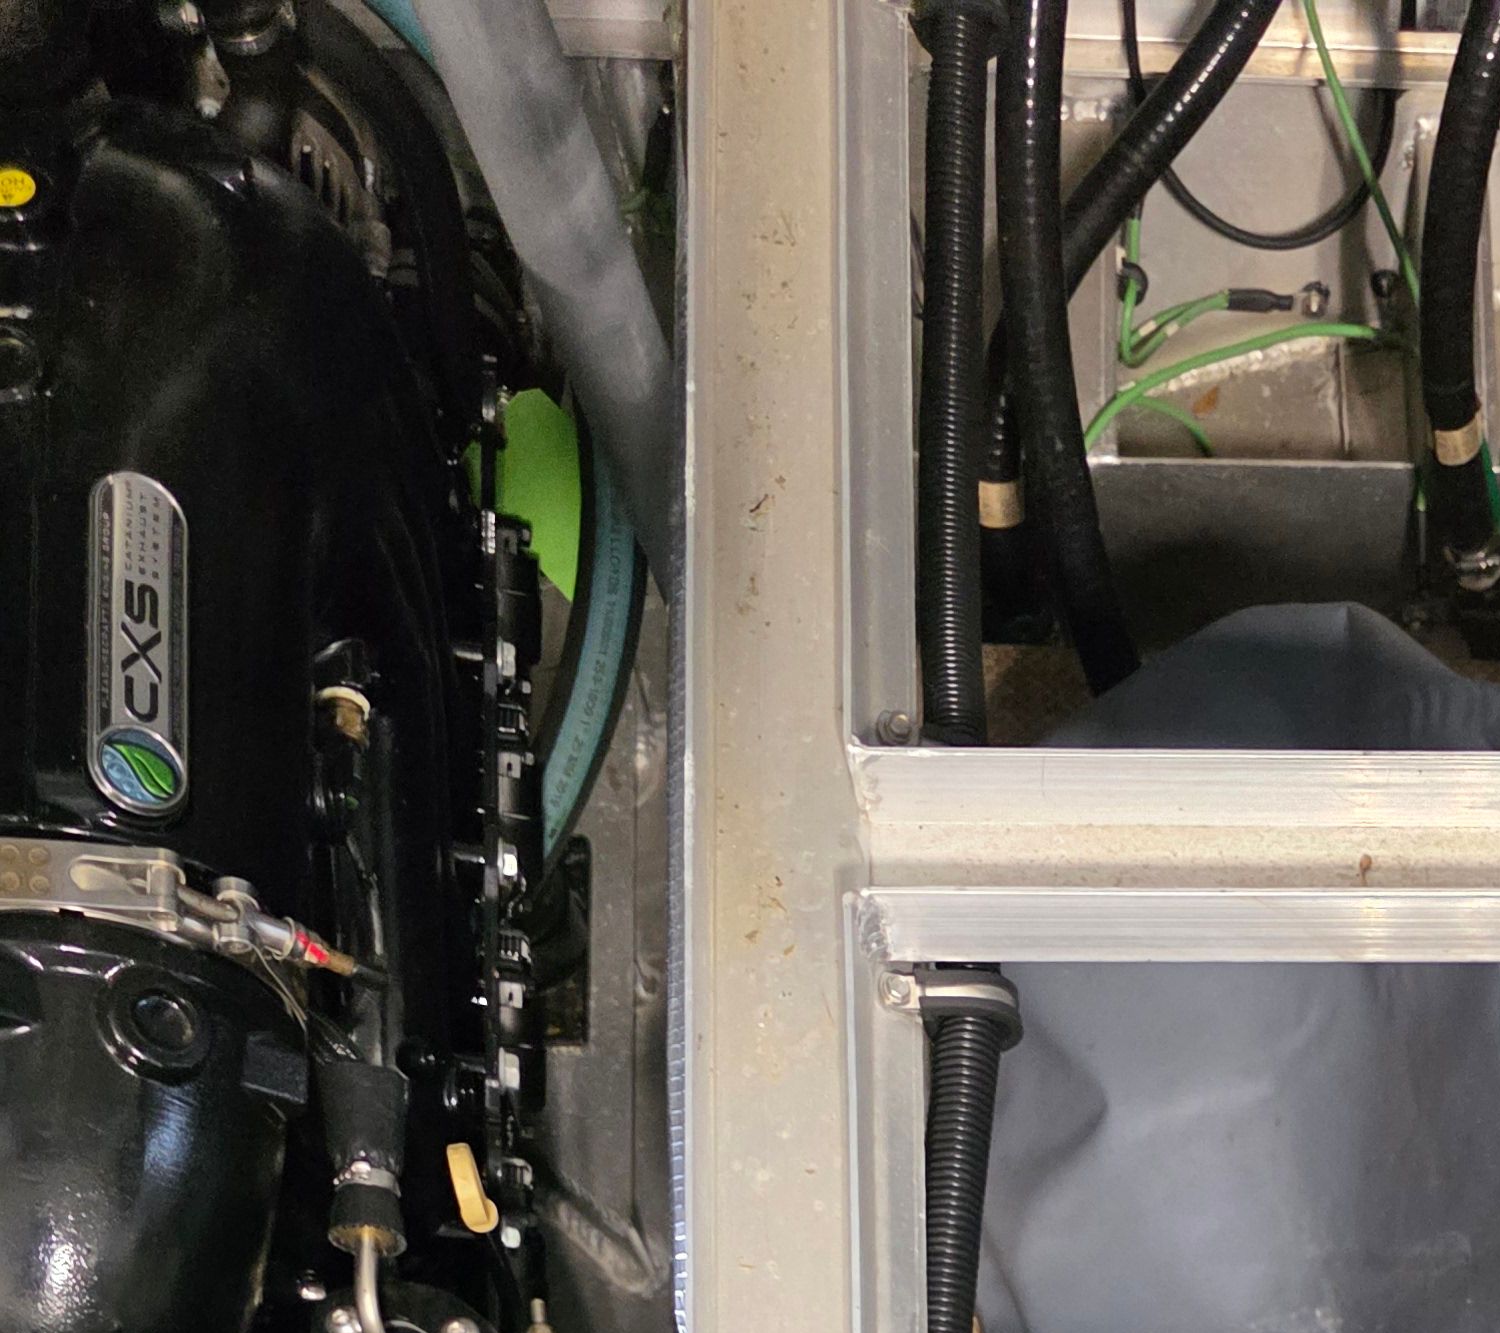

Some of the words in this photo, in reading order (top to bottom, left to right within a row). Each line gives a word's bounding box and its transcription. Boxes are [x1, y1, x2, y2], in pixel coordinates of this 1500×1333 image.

[102, 511, 110, 552] GROUP
[139, 493, 147, 576] EXHAUST
[121, 579, 162, 723] CXS
